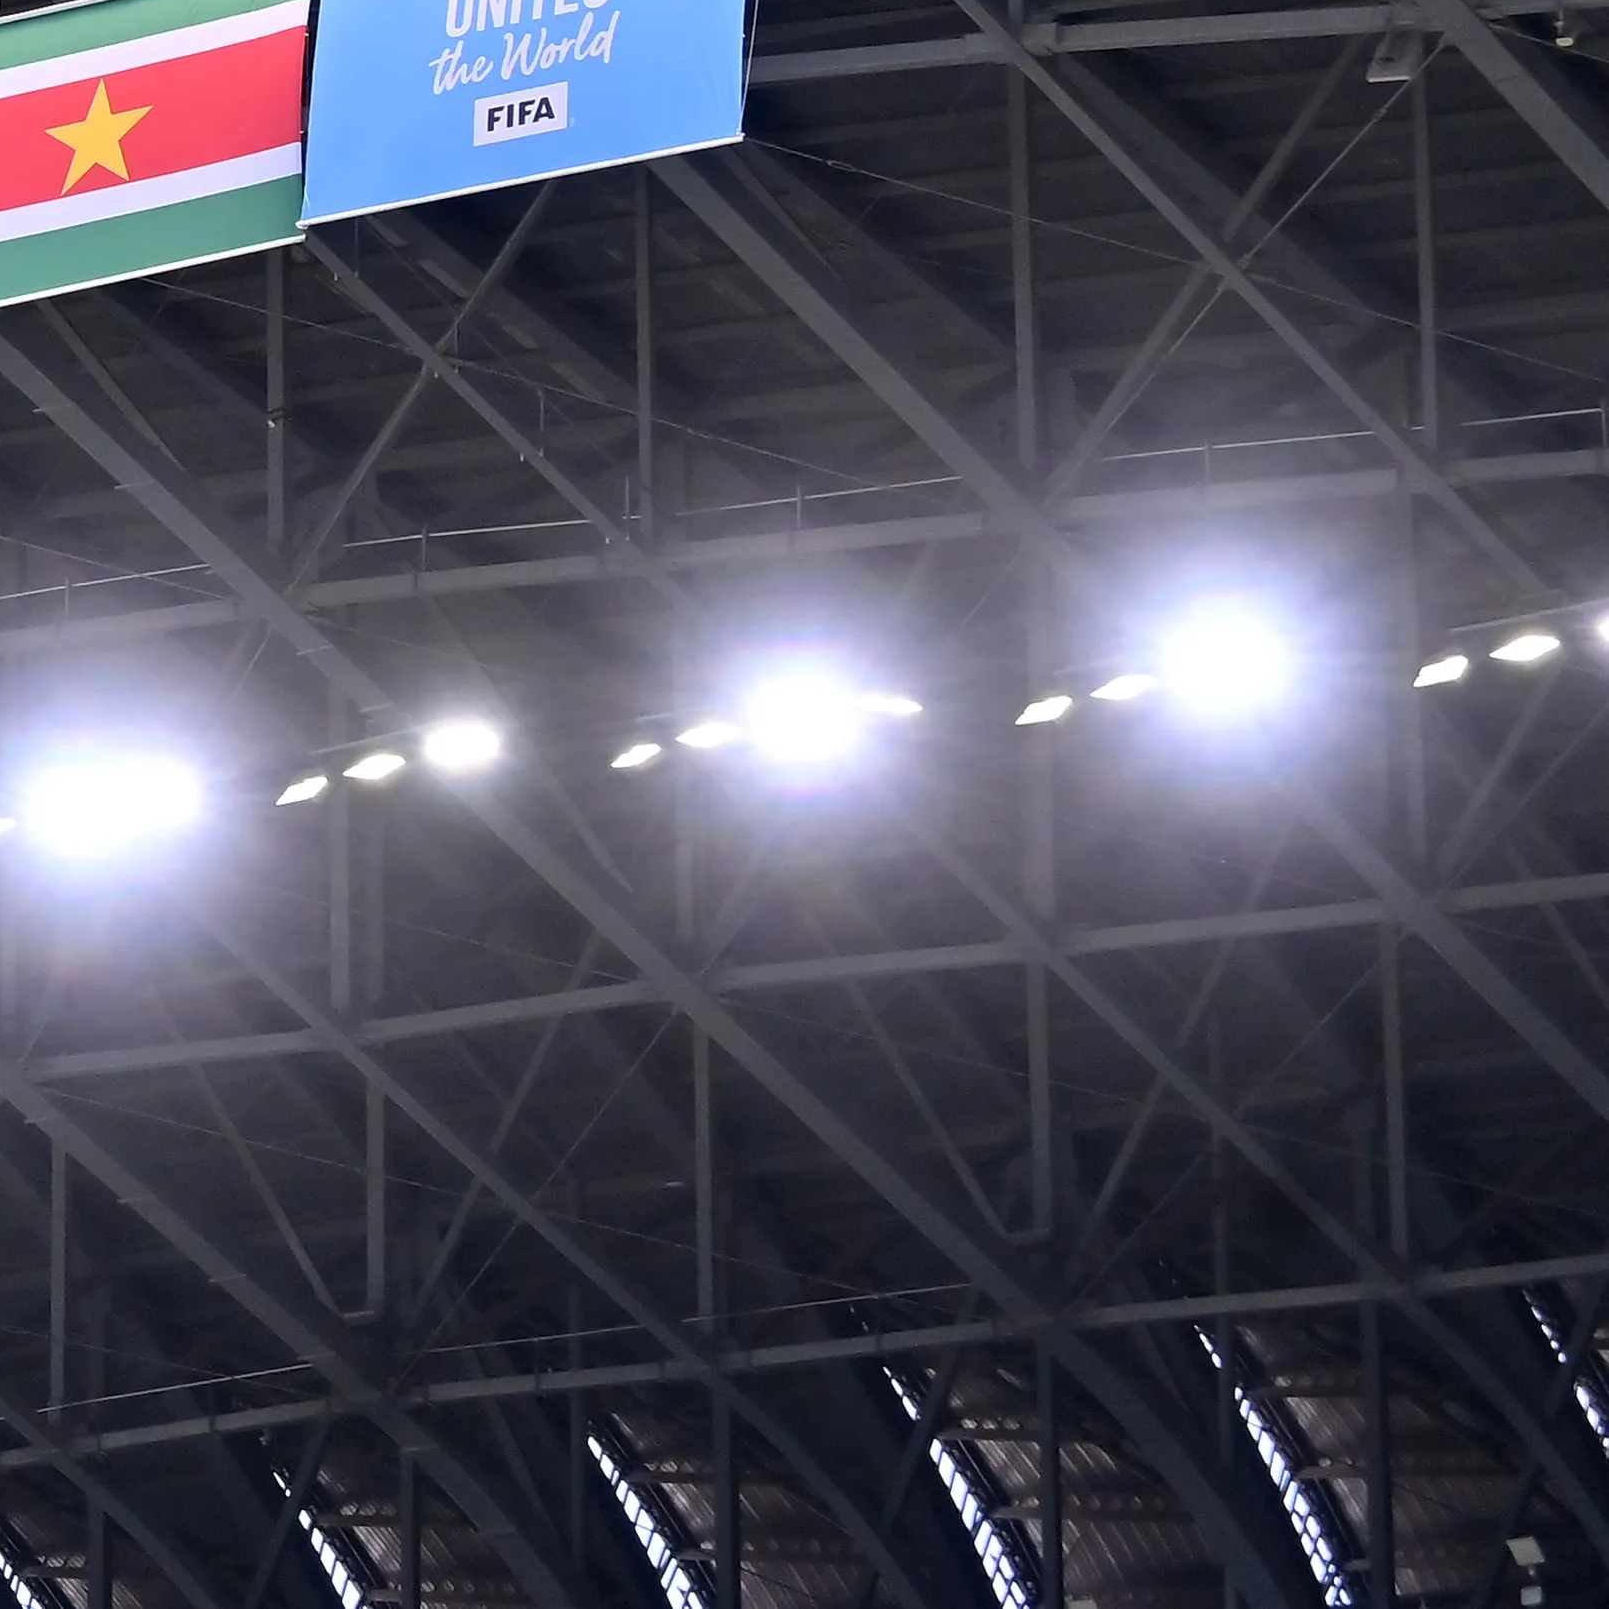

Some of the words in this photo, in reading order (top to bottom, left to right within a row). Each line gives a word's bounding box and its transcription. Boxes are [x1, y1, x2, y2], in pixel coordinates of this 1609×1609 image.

[428, 39, 494, 95] the
[500, 10, 621, 81] World
[487, 96, 556, 132] FIFA
